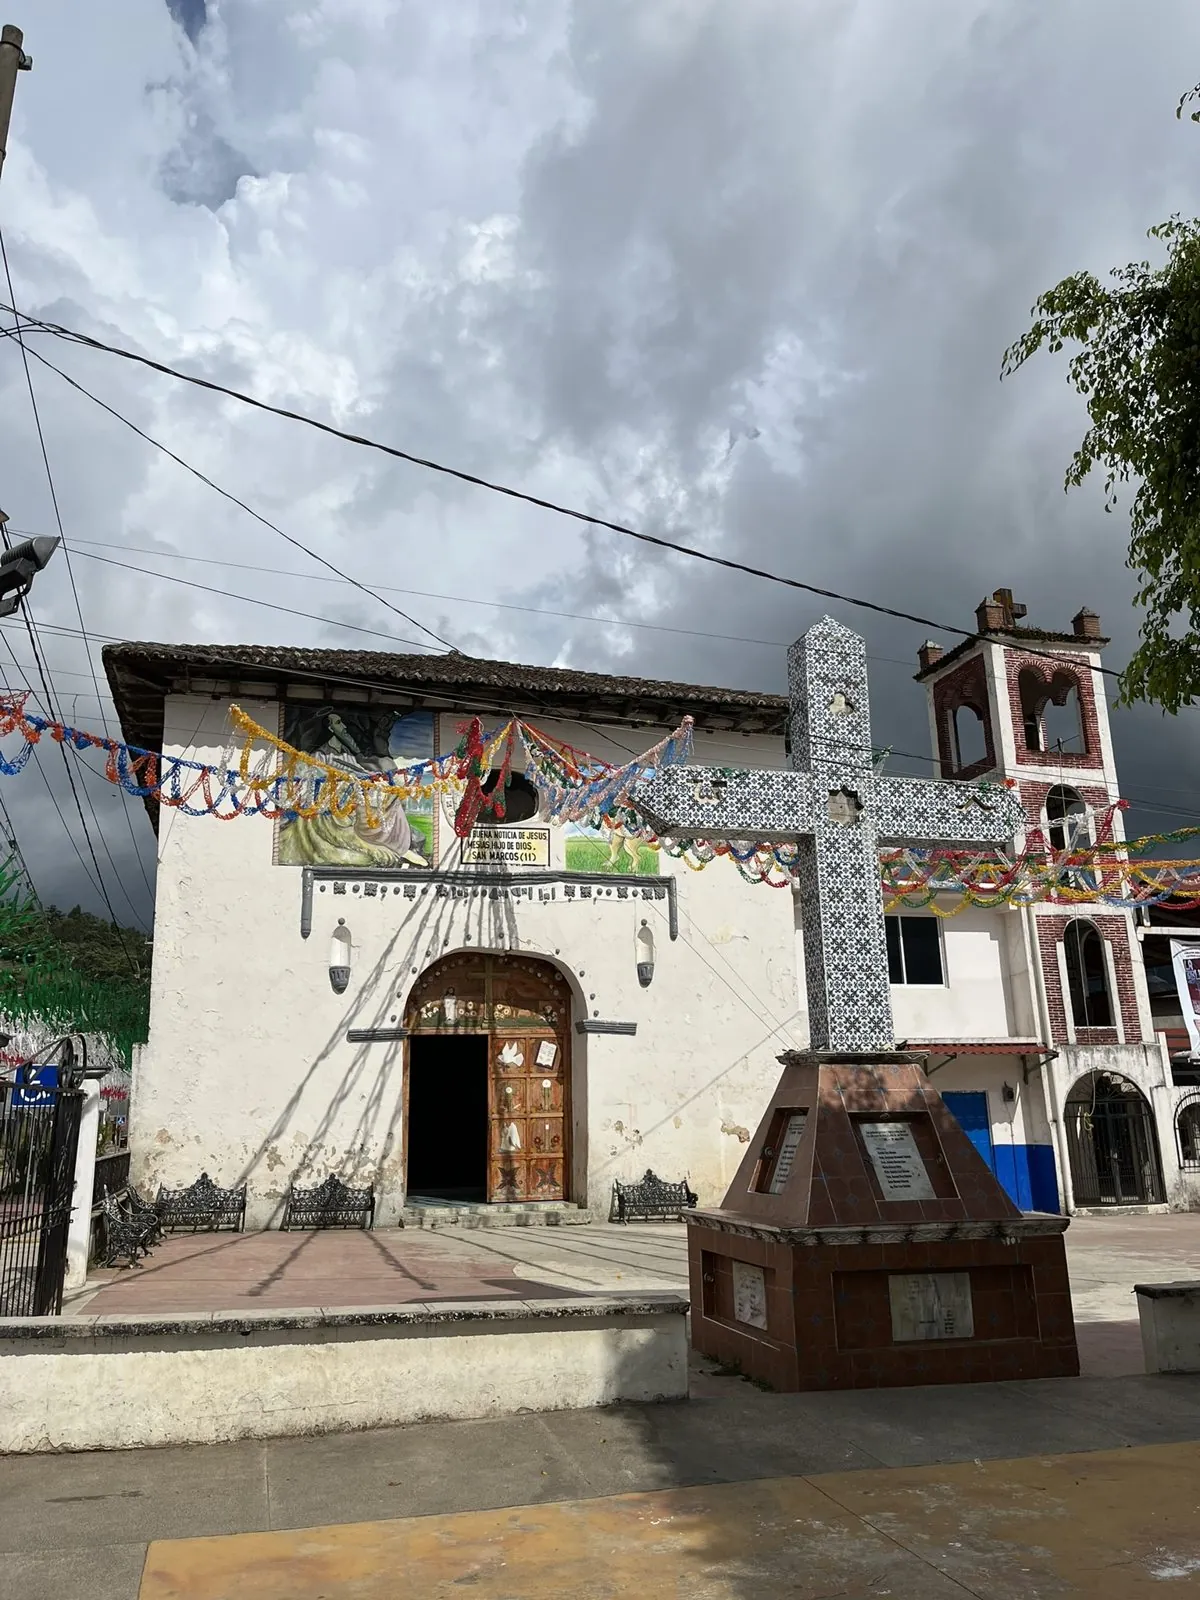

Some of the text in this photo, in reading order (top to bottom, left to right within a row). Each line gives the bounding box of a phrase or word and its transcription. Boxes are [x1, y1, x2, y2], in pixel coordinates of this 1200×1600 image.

[472, 830, 492, 839] BUENA
[494, 831, 517, 840] NOTICIA
[519, 832, 526, 840] DE
[506, 842, 514, 850] DE
[472, 851, 486, 860] SAN
[489, 851, 520, 861] MARCOS
